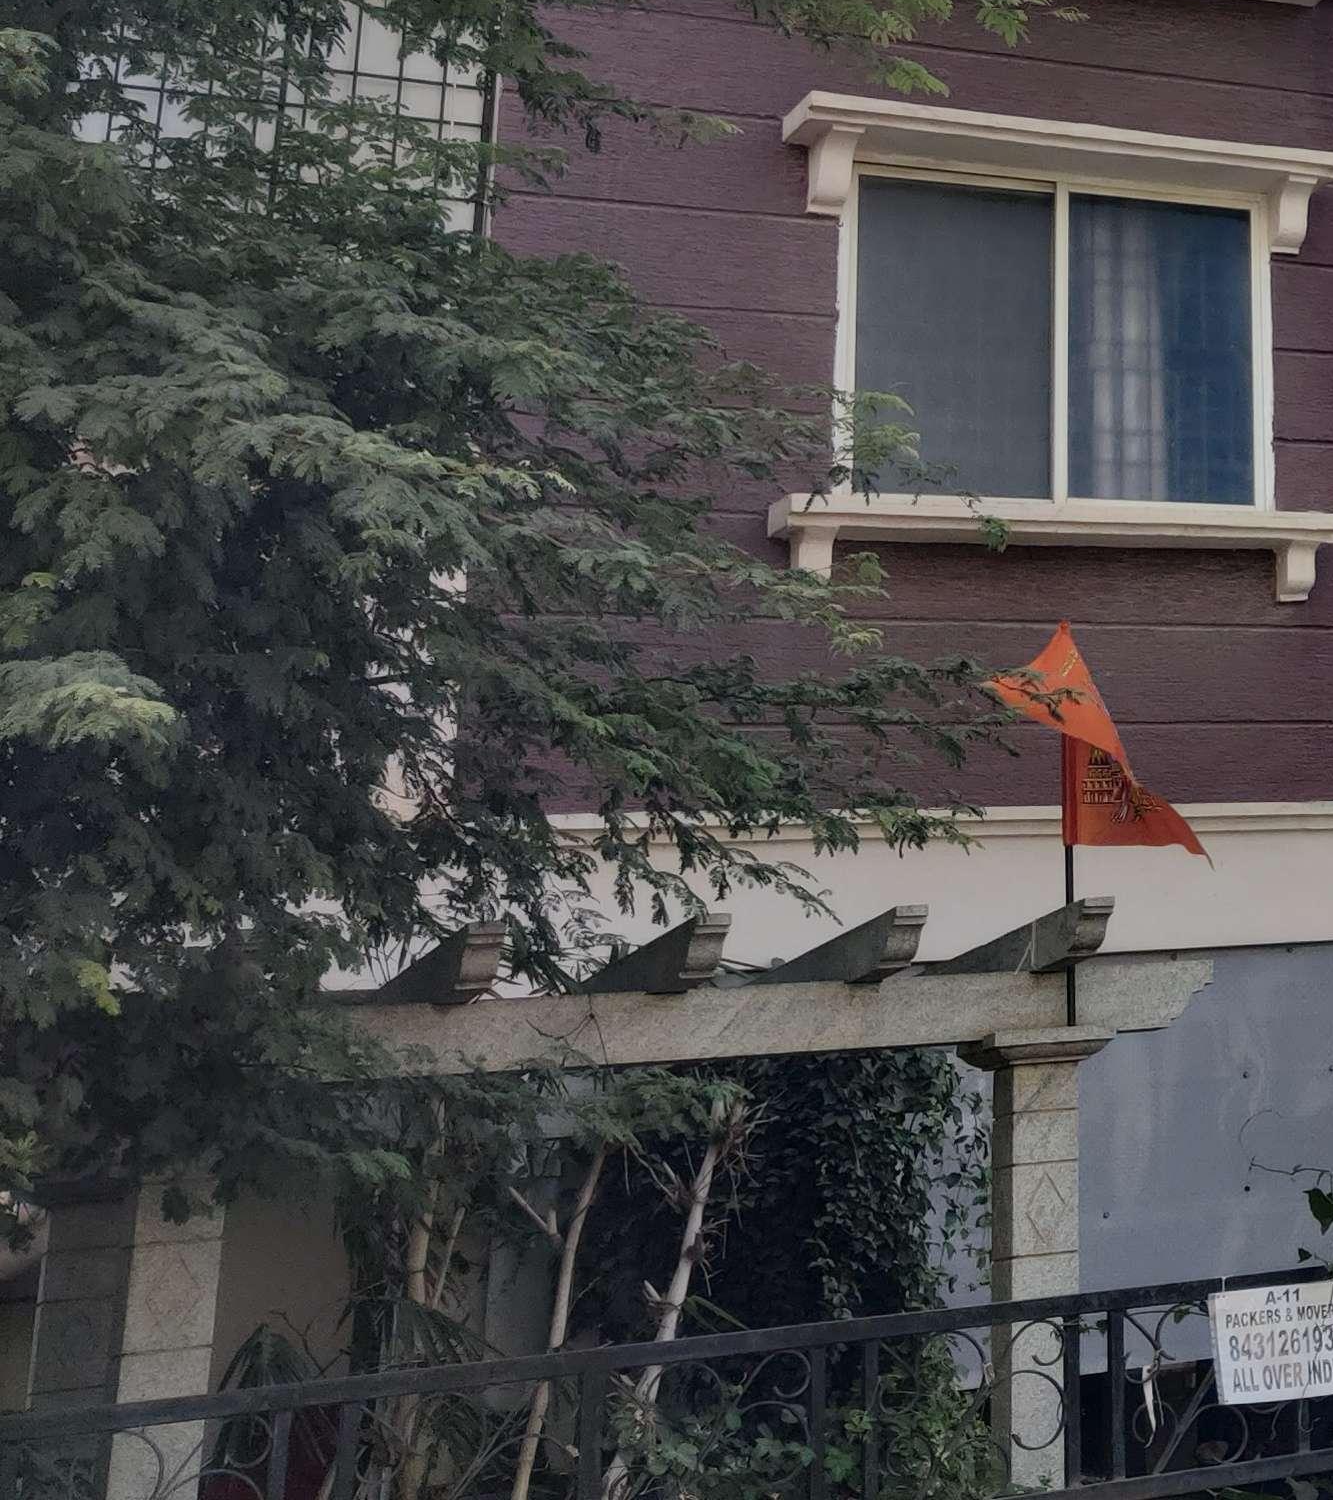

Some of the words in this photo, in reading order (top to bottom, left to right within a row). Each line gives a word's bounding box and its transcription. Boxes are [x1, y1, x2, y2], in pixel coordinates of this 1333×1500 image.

[1265, 1288, 1299, 1305] A-11
[1226, 1309, 1281, 1328] PACKERS
[1286, 1309, 1293, 1322] &
[1233, 1367, 1259, 1393] ALL
[1263, 1362, 1303, 1390] OVER
